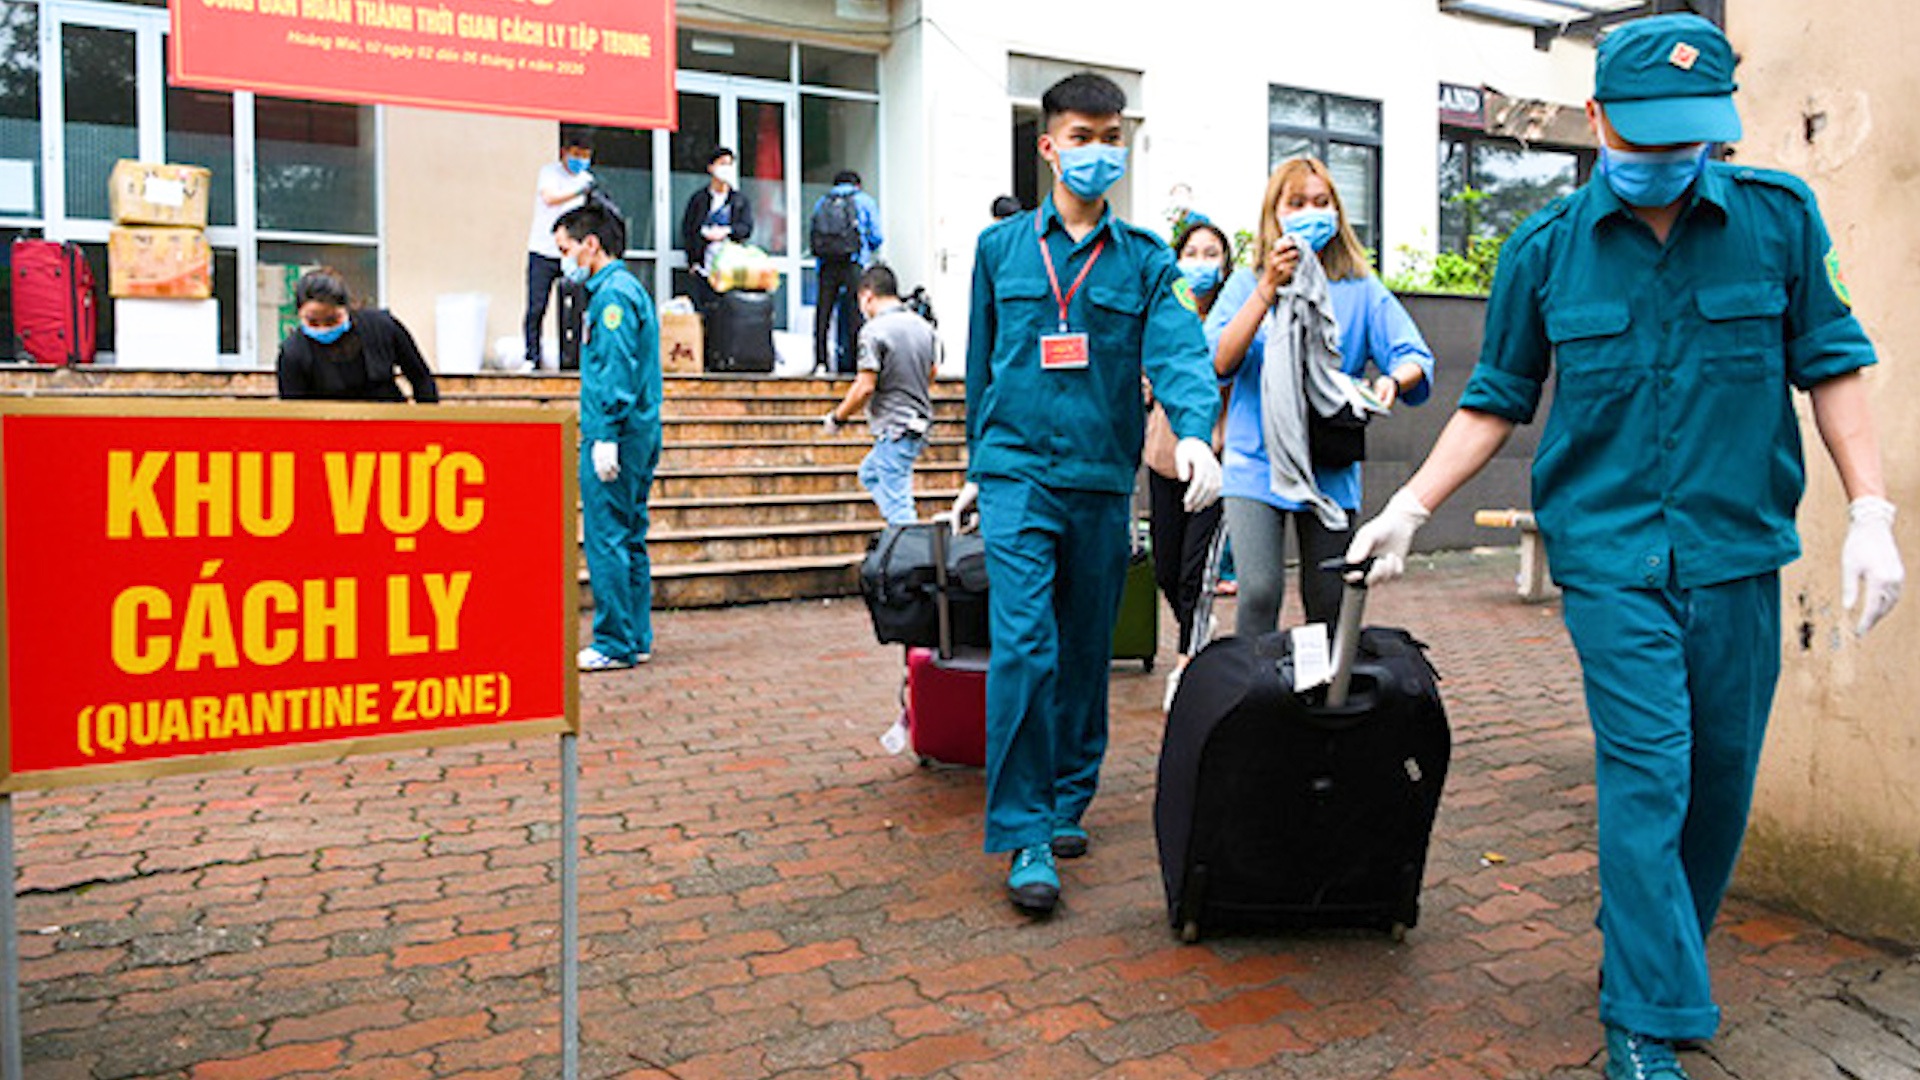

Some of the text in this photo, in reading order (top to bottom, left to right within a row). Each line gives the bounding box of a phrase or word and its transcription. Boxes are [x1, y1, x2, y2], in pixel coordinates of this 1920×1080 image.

[355, 0, 413, 31] THÀNH
[415, 3, 454, 36] THỜI
[457, 12, 498, 41] GIAN
[500, 14, 544, 46] CÁCH
[547, 23, 566, 48] LY
[568, 21, 599, 57] TẬP
[601, 29, 651, 58] TRUNG
[107, 444, 485, 552] KHU VỰC
[111, 559, 472, 674] CÁCH LY
[77, 673, 511, 756] (QUARANTINE ZONE)
